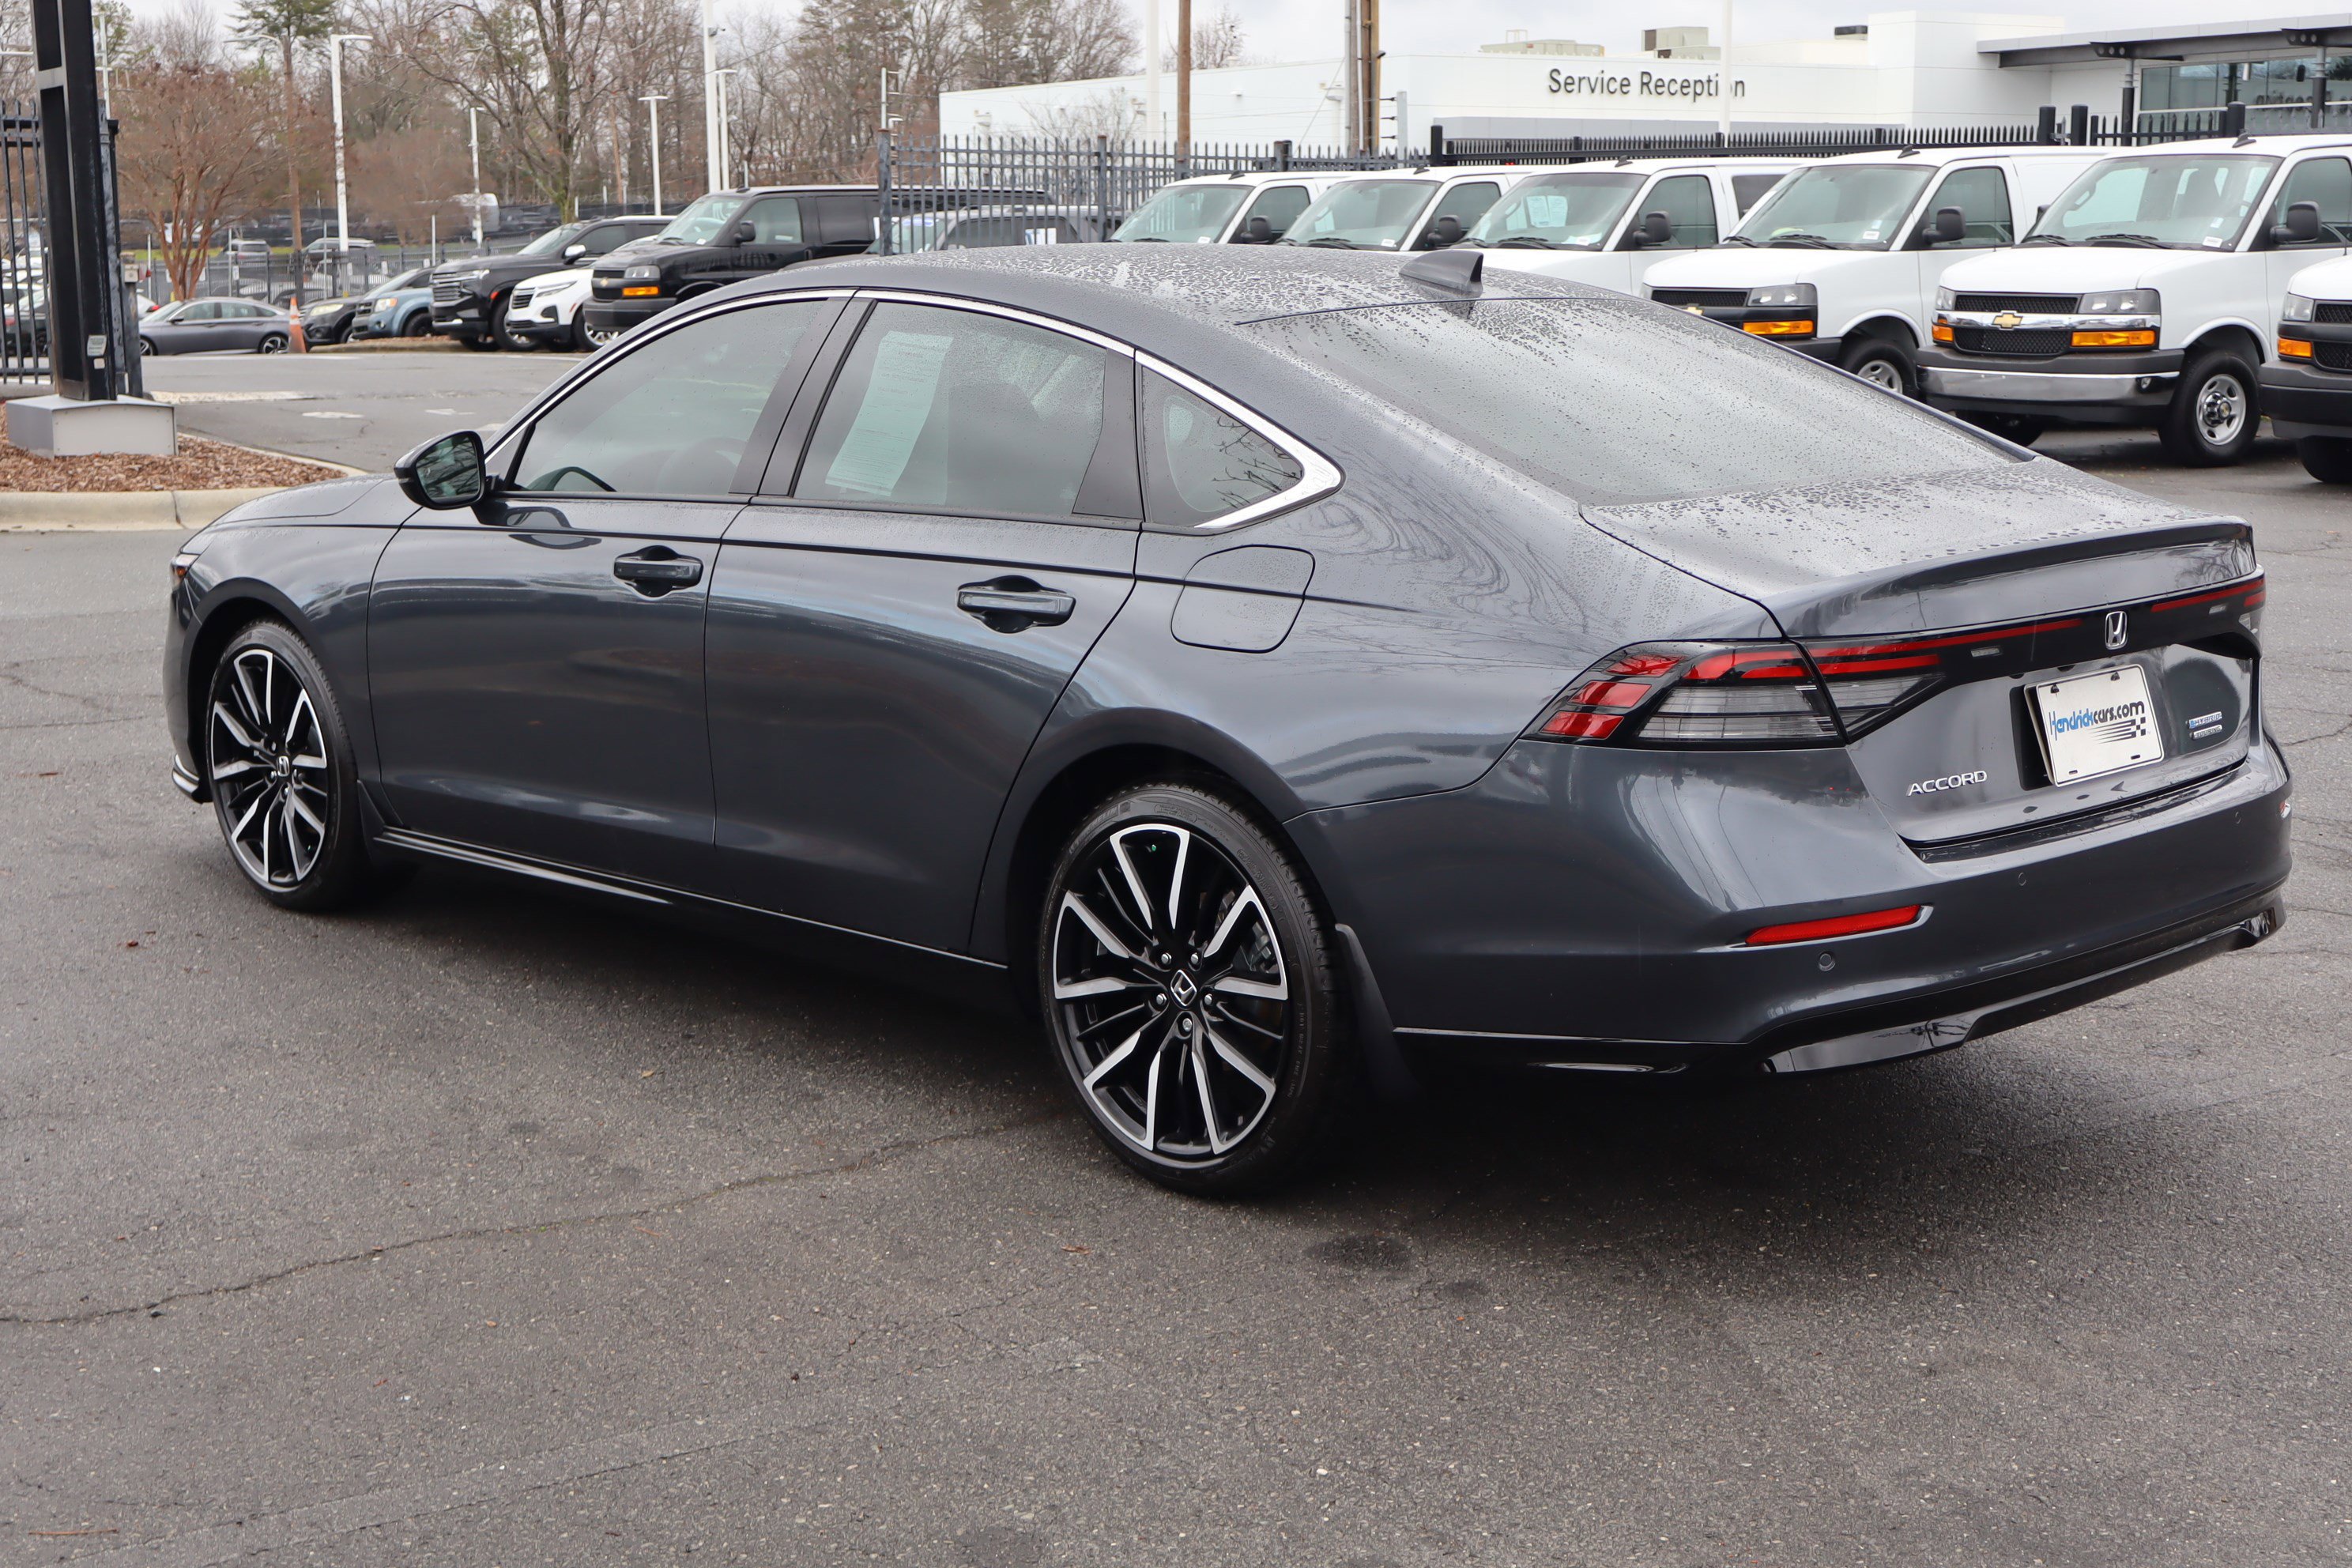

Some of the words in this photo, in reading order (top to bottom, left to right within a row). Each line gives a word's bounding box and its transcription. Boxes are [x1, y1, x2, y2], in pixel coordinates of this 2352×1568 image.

[1548, 68, 1631, 95] Service
[1640, 70, 1746, 103] Receptin
[2049, 701, 2145, 741] Hendrickcars.com
[1906, 770, 1988, 797] ACCORD
